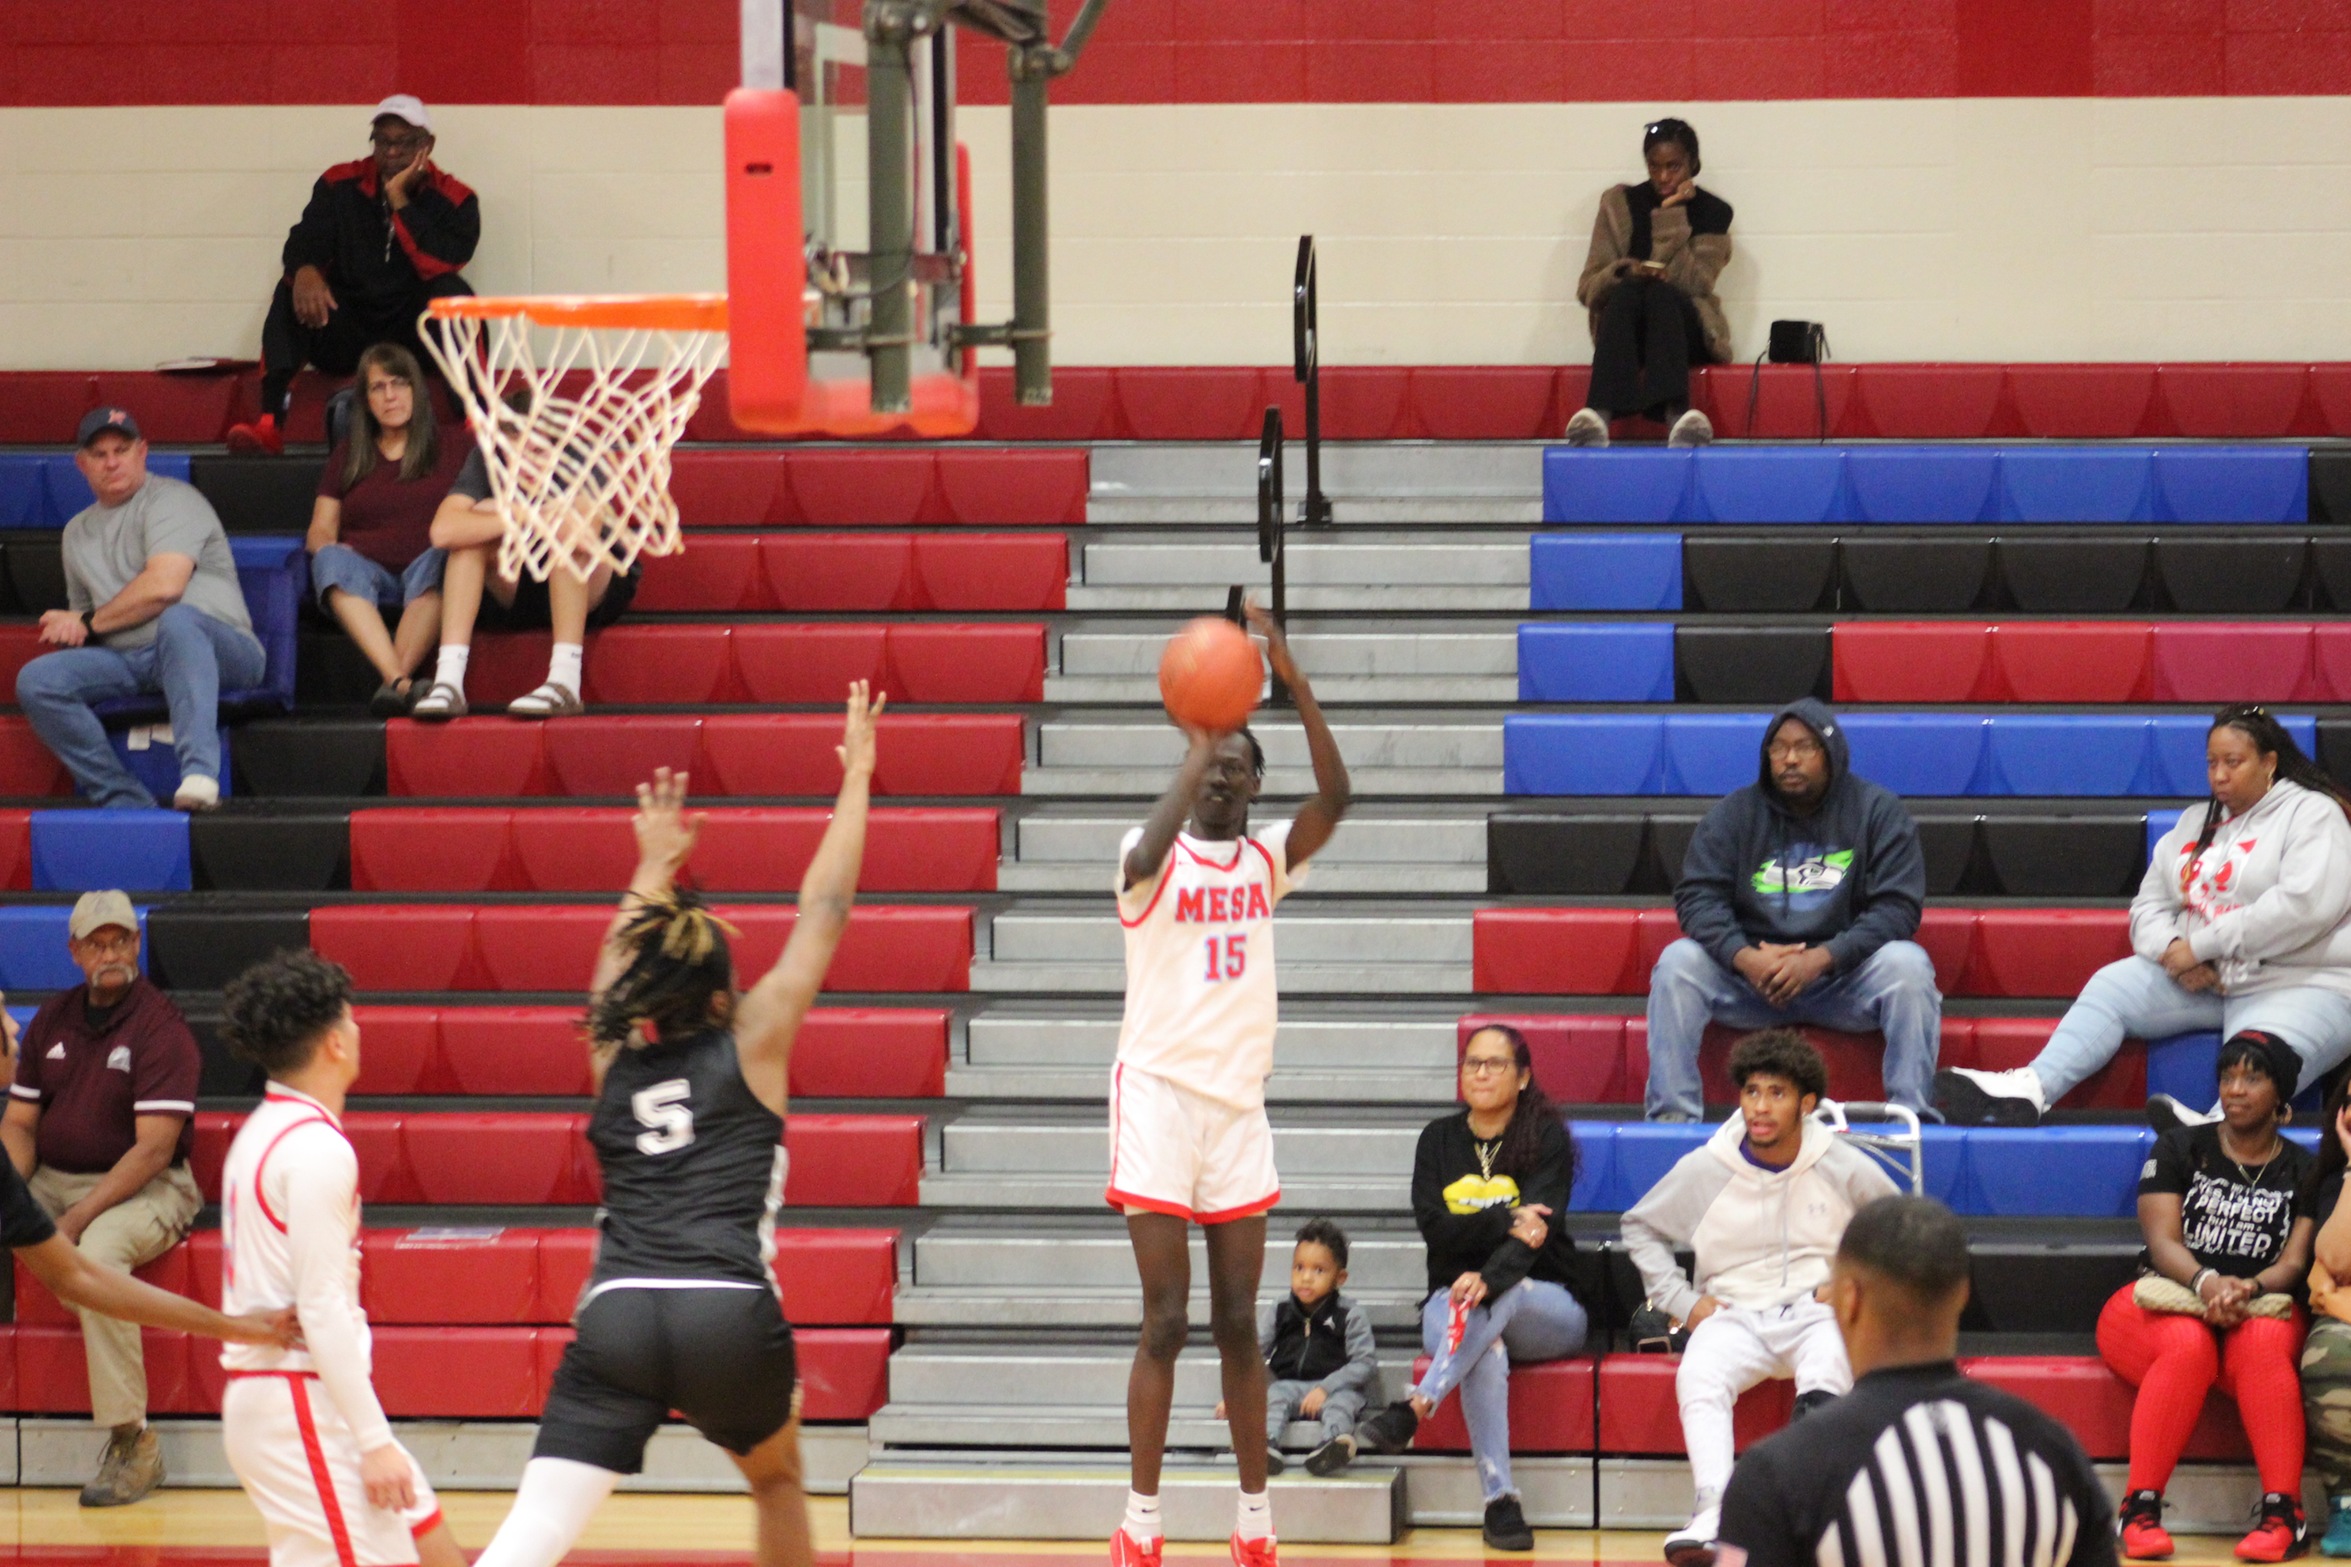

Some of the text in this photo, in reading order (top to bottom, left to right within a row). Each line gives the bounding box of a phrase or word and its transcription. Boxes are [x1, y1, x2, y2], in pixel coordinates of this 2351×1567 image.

[1175, 882, 1269, 922] MESA
[1204, 933, 1246, 980] 15
[631, 1078, 695, 1155] 5
[2194, 1194, 2276, 1224] PERFECT
